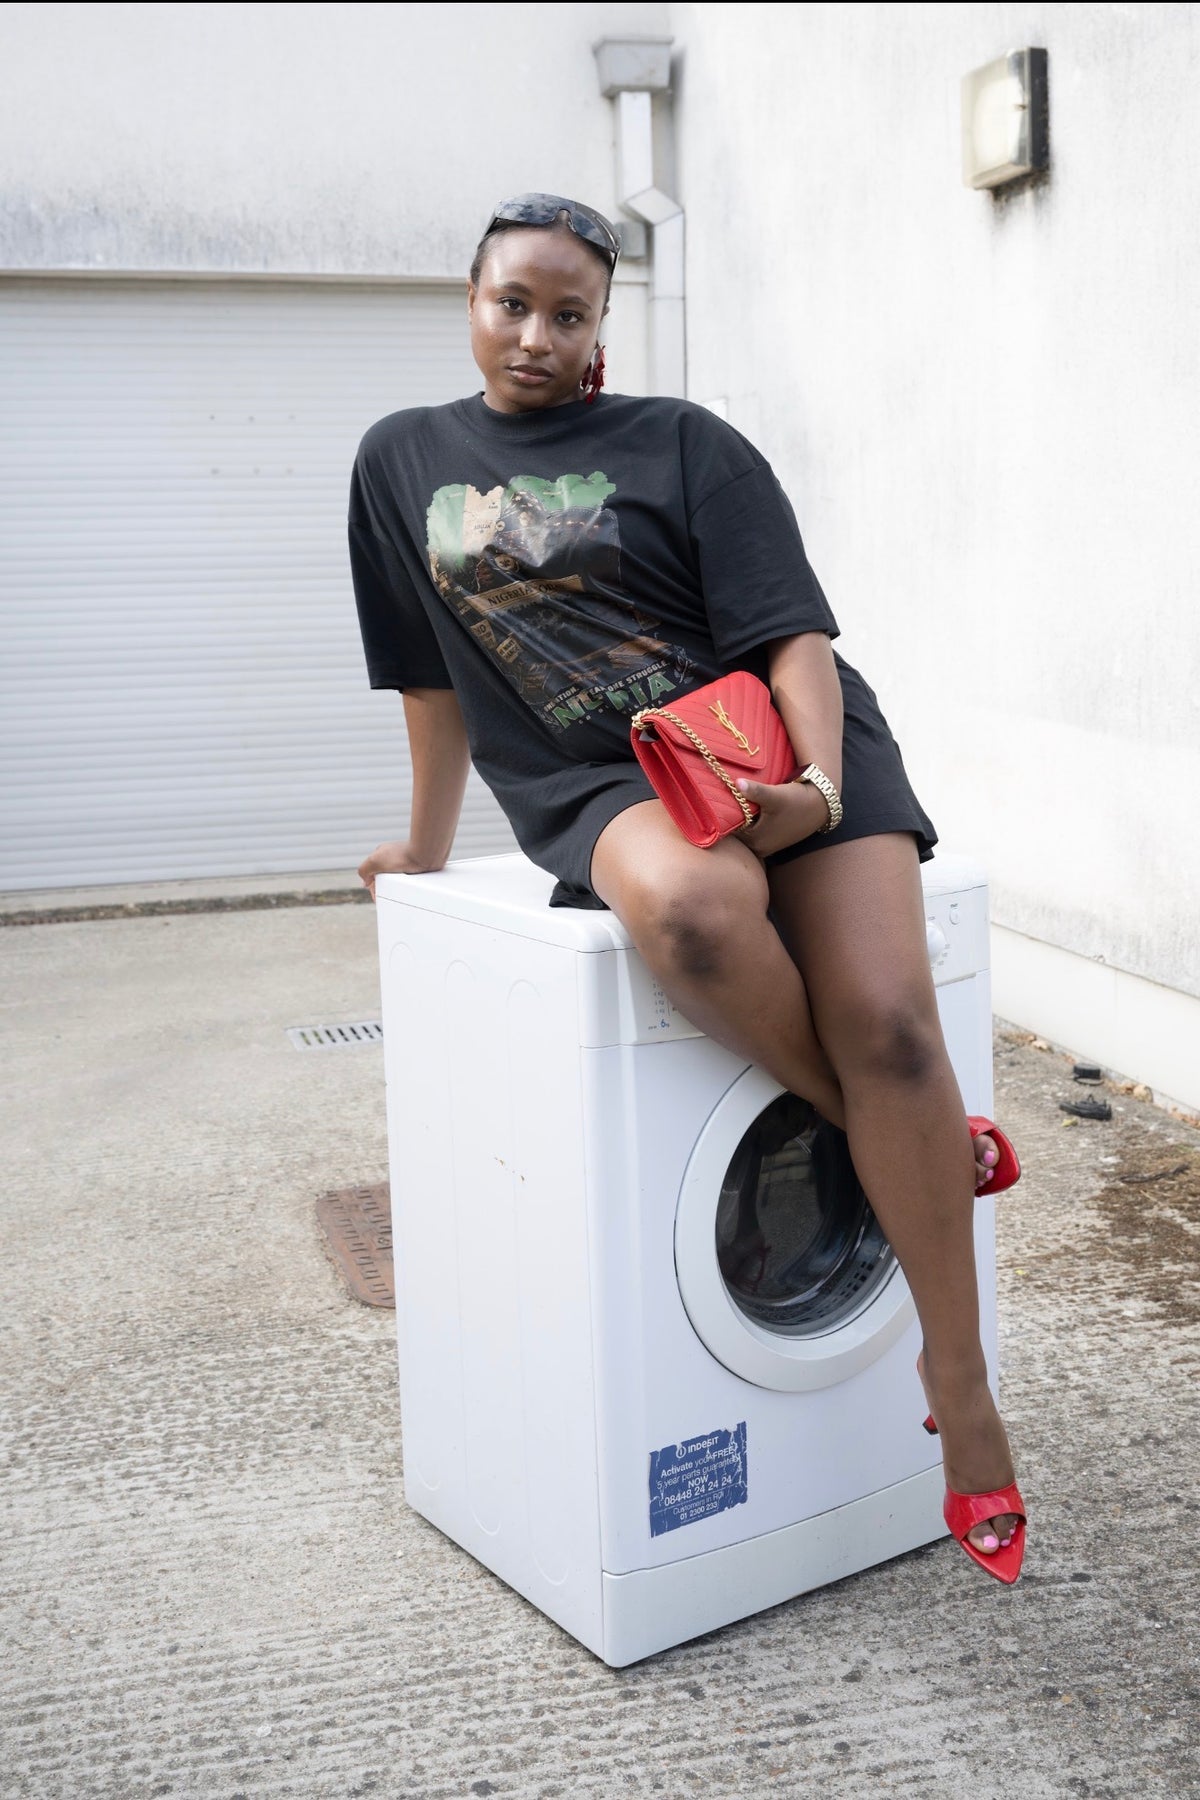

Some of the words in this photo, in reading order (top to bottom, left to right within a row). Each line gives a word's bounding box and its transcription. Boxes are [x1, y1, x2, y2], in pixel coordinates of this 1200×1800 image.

[661, 1461, 694, 1479] Activate
[663, 1475, 681, 1489] year
[682, 1469, 701, 1483] parts
[664, 1489, 693, 1506] 08448
[694, 1484, 706, 1497] 24
[708, 1480, 719, 1492] 24
[721, 1475, 732, 1487] 24
[688, 1475, 709, 1489] NOW
